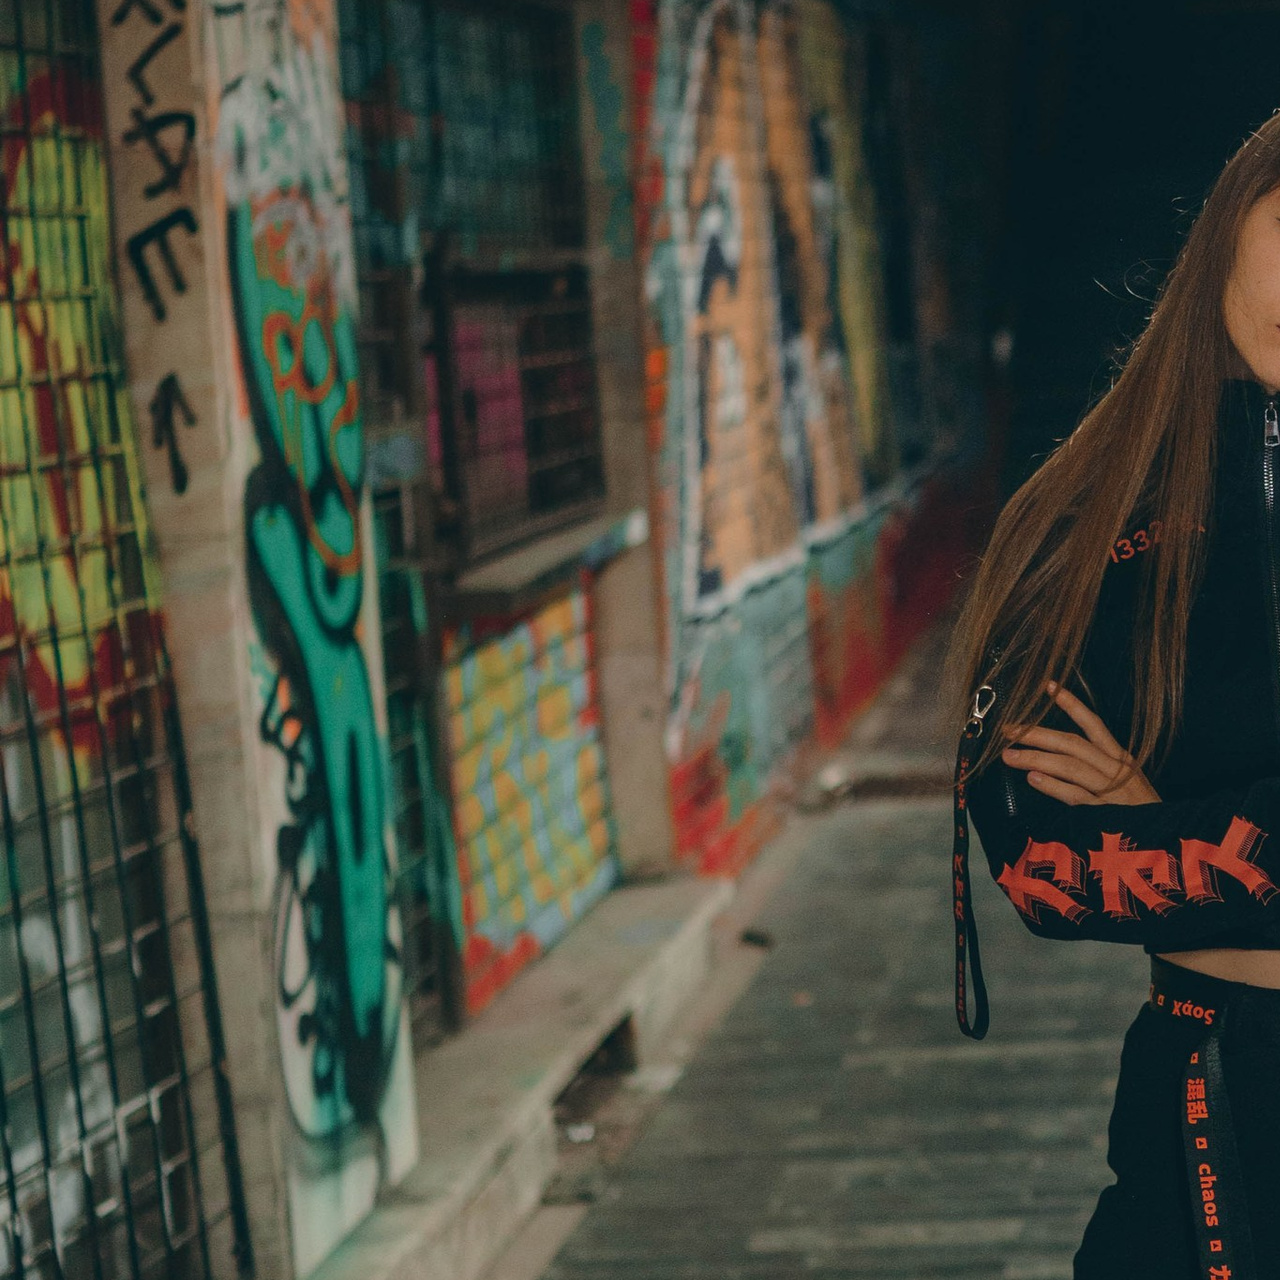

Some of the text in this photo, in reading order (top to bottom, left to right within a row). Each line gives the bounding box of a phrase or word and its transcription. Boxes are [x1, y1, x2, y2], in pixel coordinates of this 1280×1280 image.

[1172, 999, 1216, 1026] χάος
[1186, 1077, 1209, 1125] 混乱
[1198, 1163, 1219, 1227] chaos
